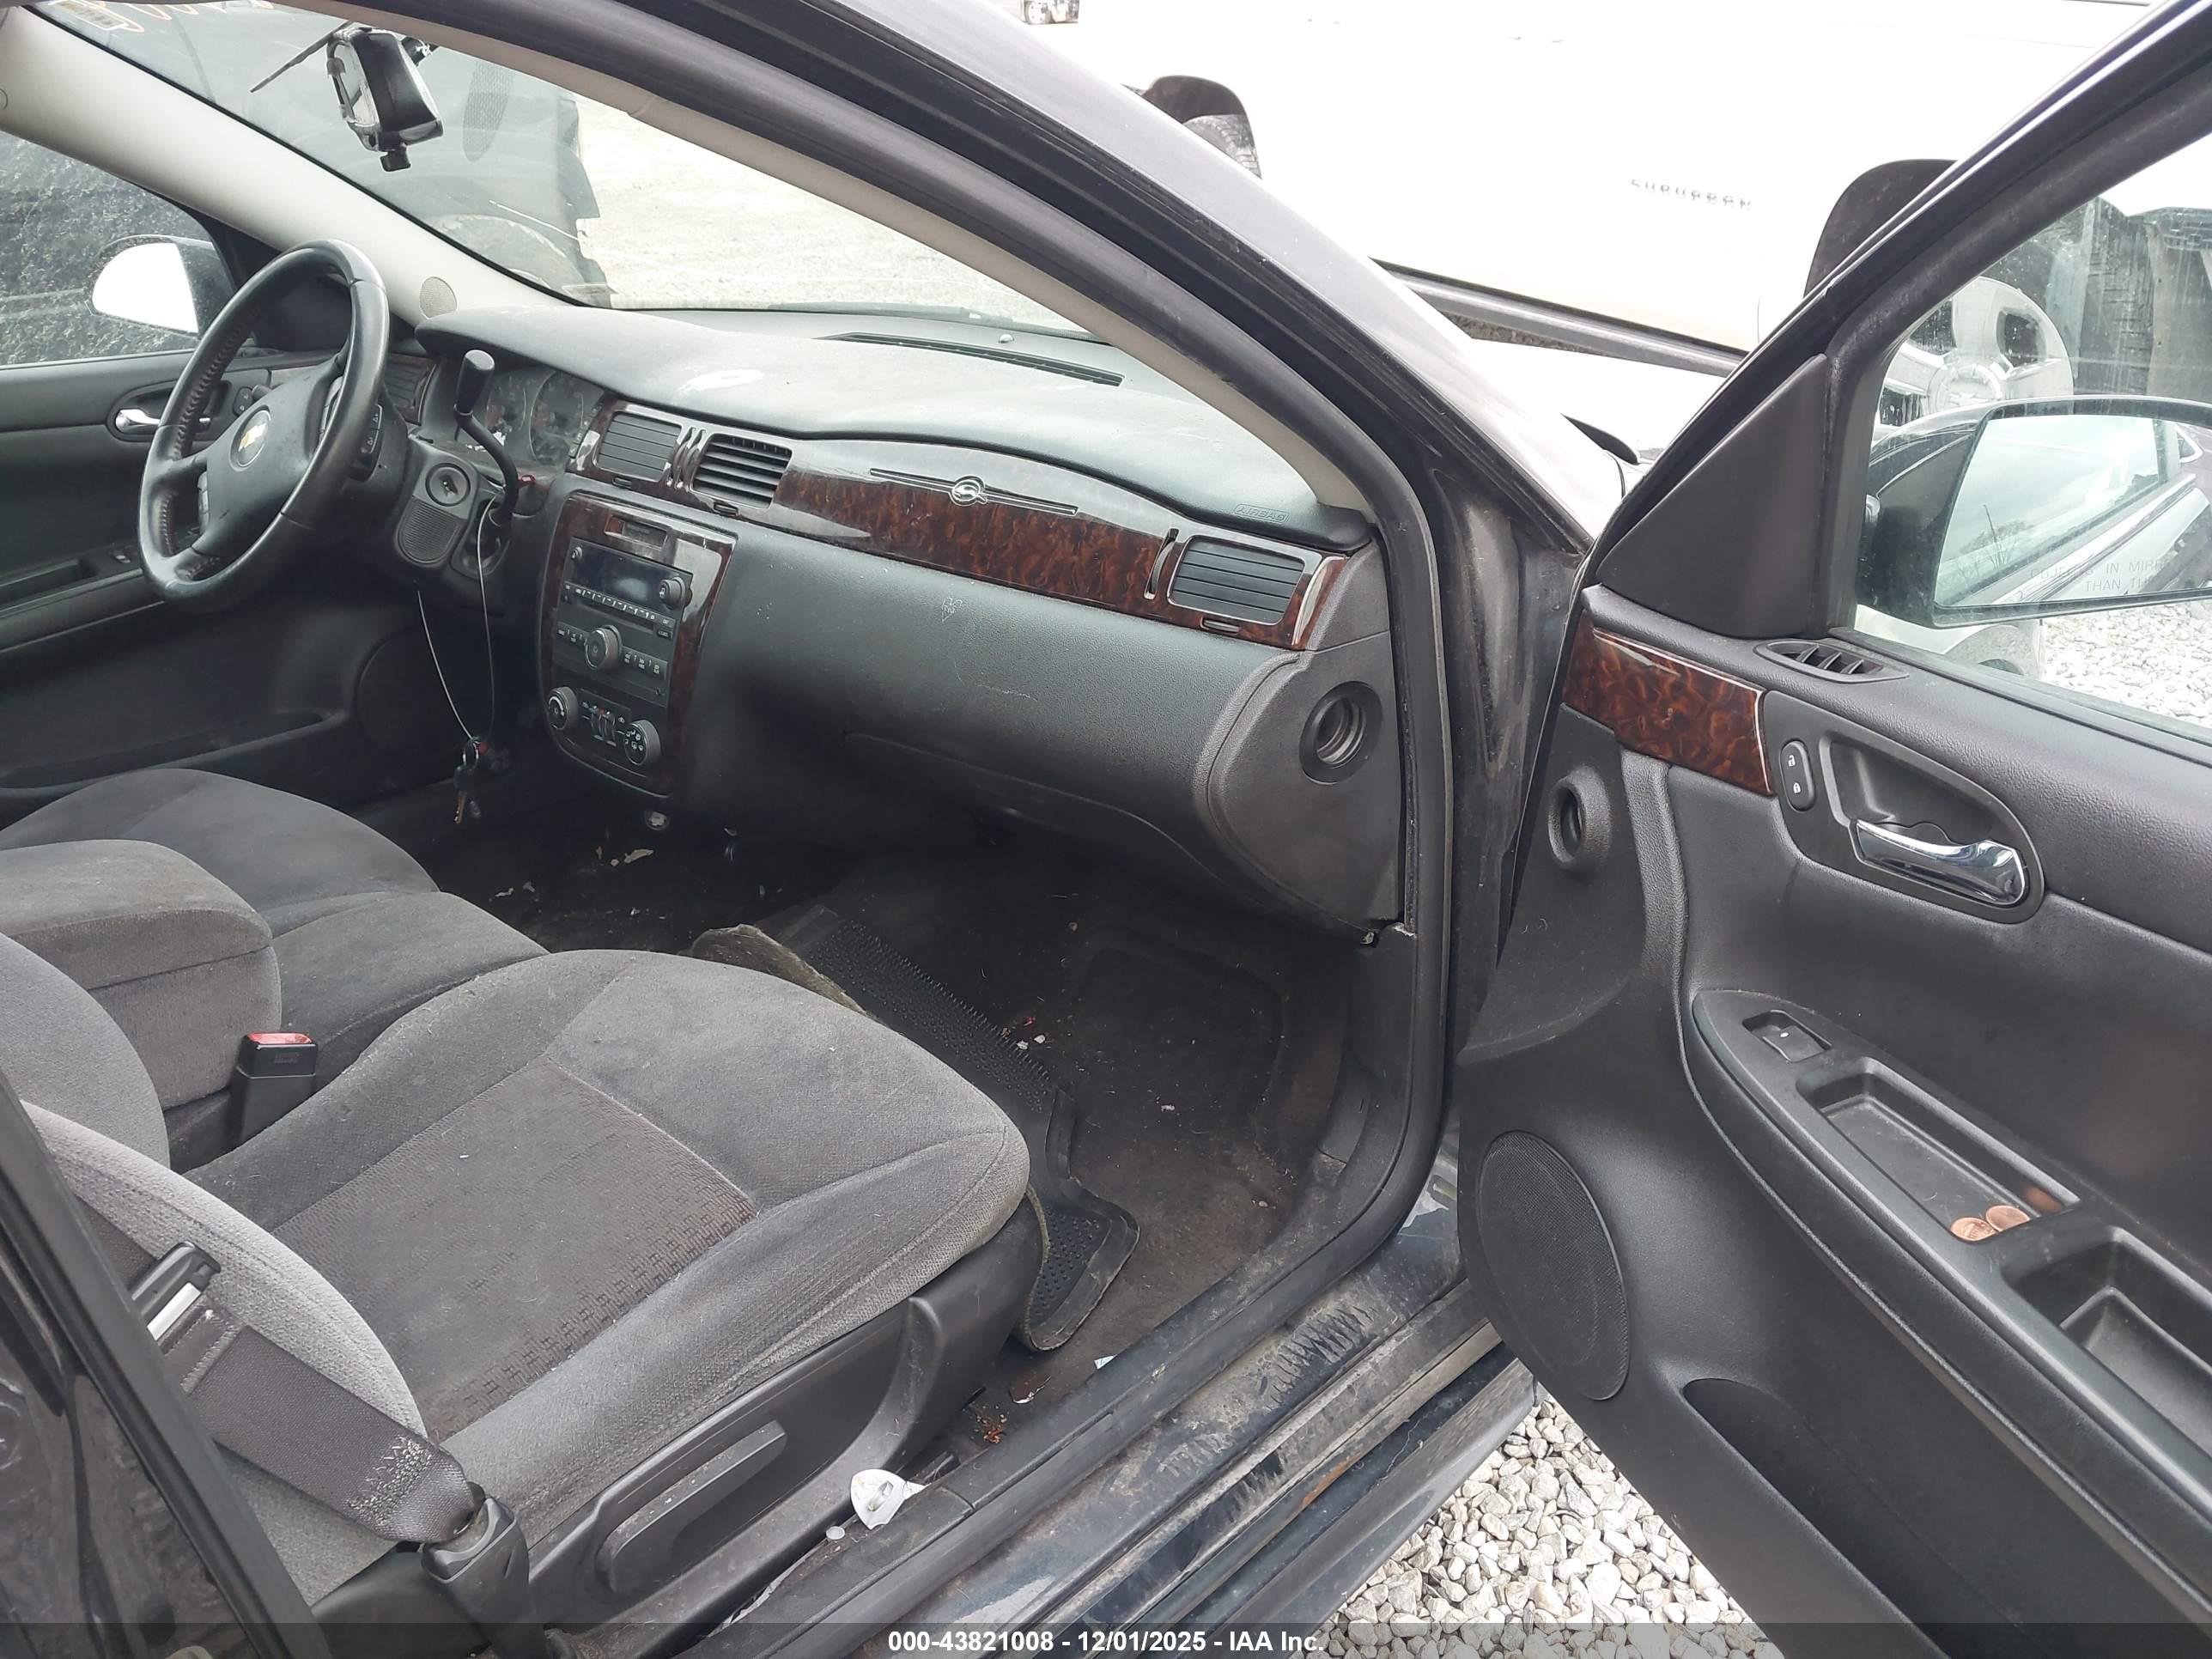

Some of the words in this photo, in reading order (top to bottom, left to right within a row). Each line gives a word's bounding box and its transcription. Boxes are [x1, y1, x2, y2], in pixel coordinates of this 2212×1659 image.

[1237, 507, 1286, 521] AIRBAG
[2106, 562, 2119, 574] IN
[2086, 579, 2121, 592] THAN
